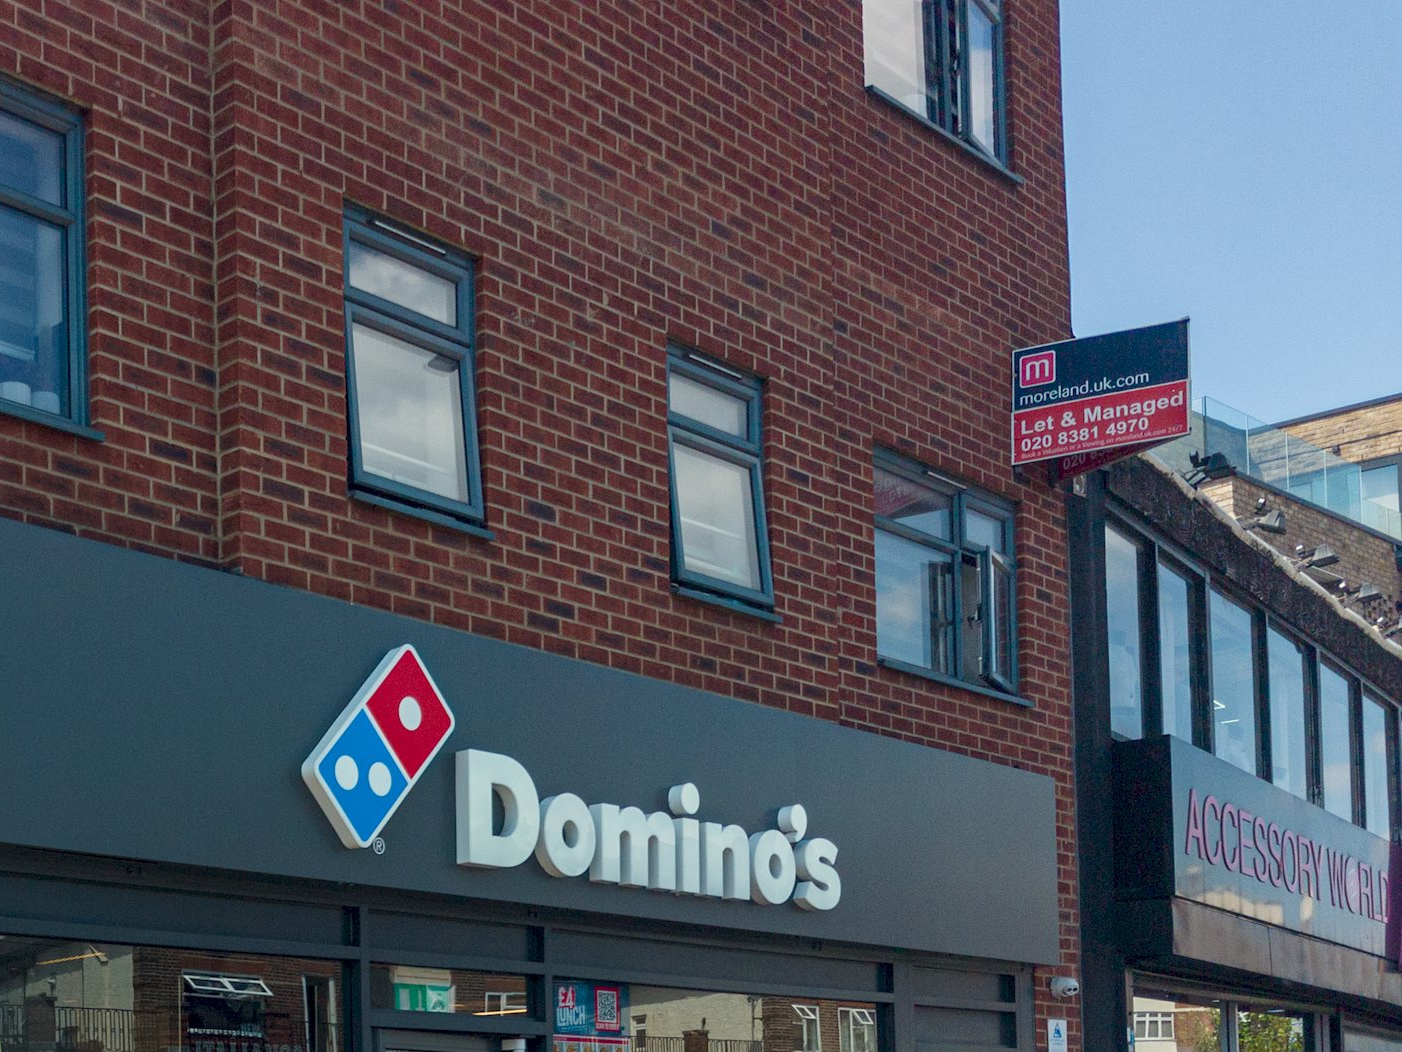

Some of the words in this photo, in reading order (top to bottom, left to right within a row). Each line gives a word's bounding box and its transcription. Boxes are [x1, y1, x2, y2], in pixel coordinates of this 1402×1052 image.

[1019, 372, 1149, 406] moreland.uk.com
[1021, 417, 1055, 435] Let
[1061, 411, 1076, 427] &
[1083, 390, 1184, 424] Managed
[1021, 434, 1053, 451] 020
[1057, 426, 1099, 445] 8381
[1105, 417, 1149, 436] 4970
[1082, 439, 1105, 448] Viewing
[1114, 427, 1167, 443] moreland.uk.com
[455, 749, 842, 911] Domino's
[1185, 788, 1325, 901] ACCESSORY
[1326, 847, 1389, 924] WORLD
[558, 985, 575, 1008] £4
[557, 1005, 586, 1027] LUNCH
